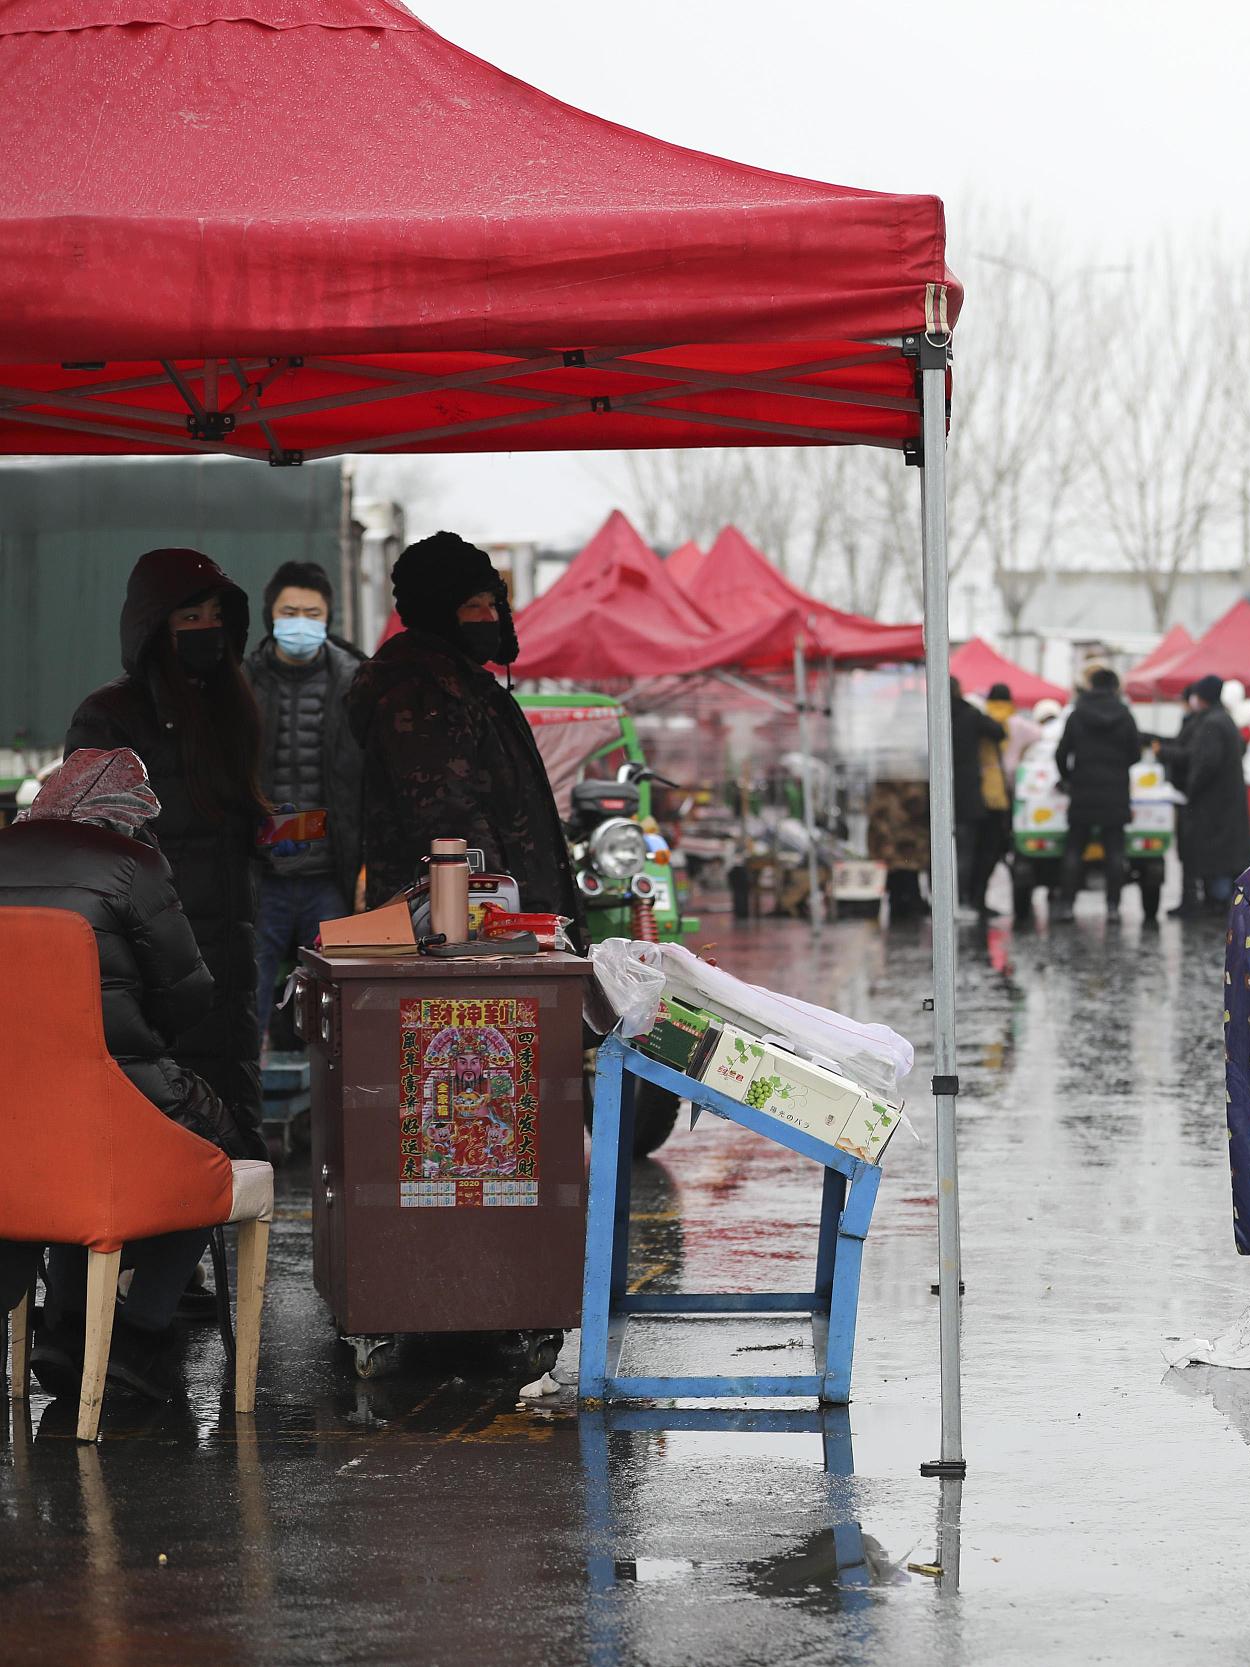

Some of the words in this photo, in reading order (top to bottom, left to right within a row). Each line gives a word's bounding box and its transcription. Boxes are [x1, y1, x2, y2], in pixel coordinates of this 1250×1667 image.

[515, 1031, 539, 1178] 四季平安发大财
[458, 1180, 480, 1188] 2020
